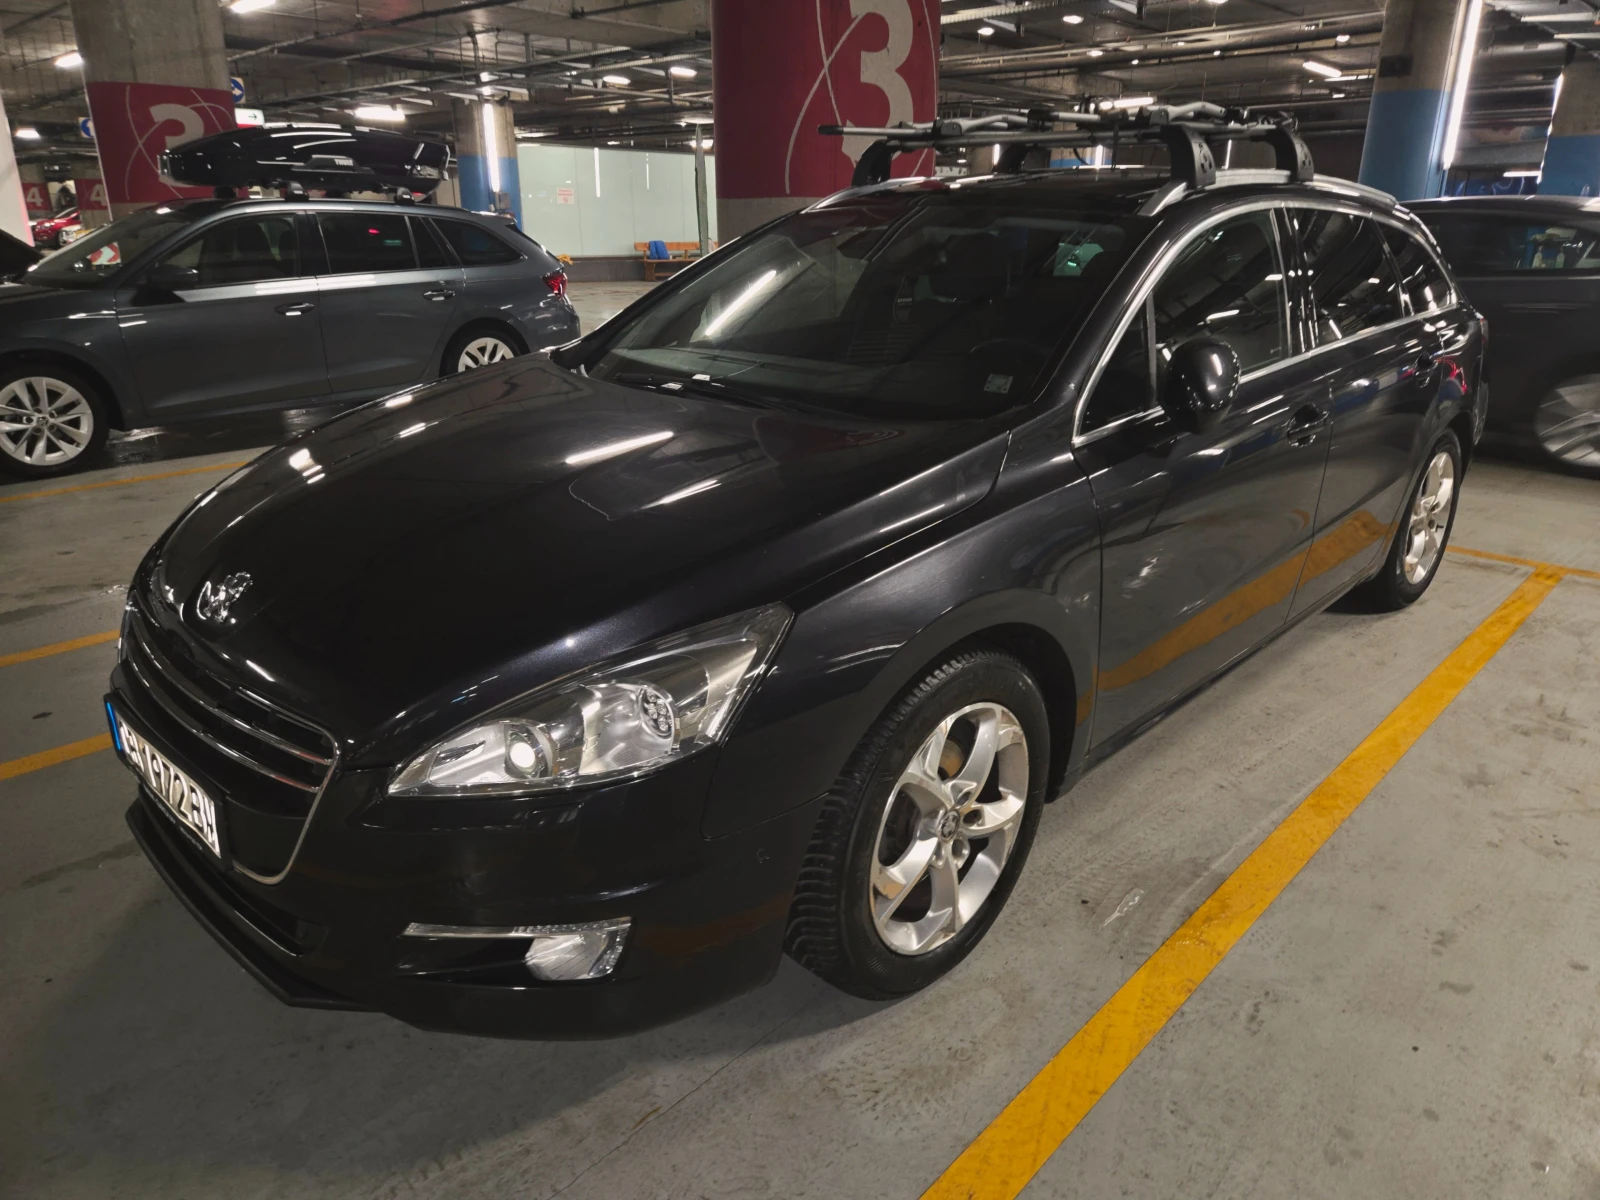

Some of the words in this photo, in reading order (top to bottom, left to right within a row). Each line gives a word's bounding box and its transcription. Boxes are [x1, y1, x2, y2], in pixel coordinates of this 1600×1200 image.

[842, 0, 914, 168] 3
[26, 186, 44, 207] 4
[90, 183, 108, 207] 4
[141, 743, 191, 821] 1972
